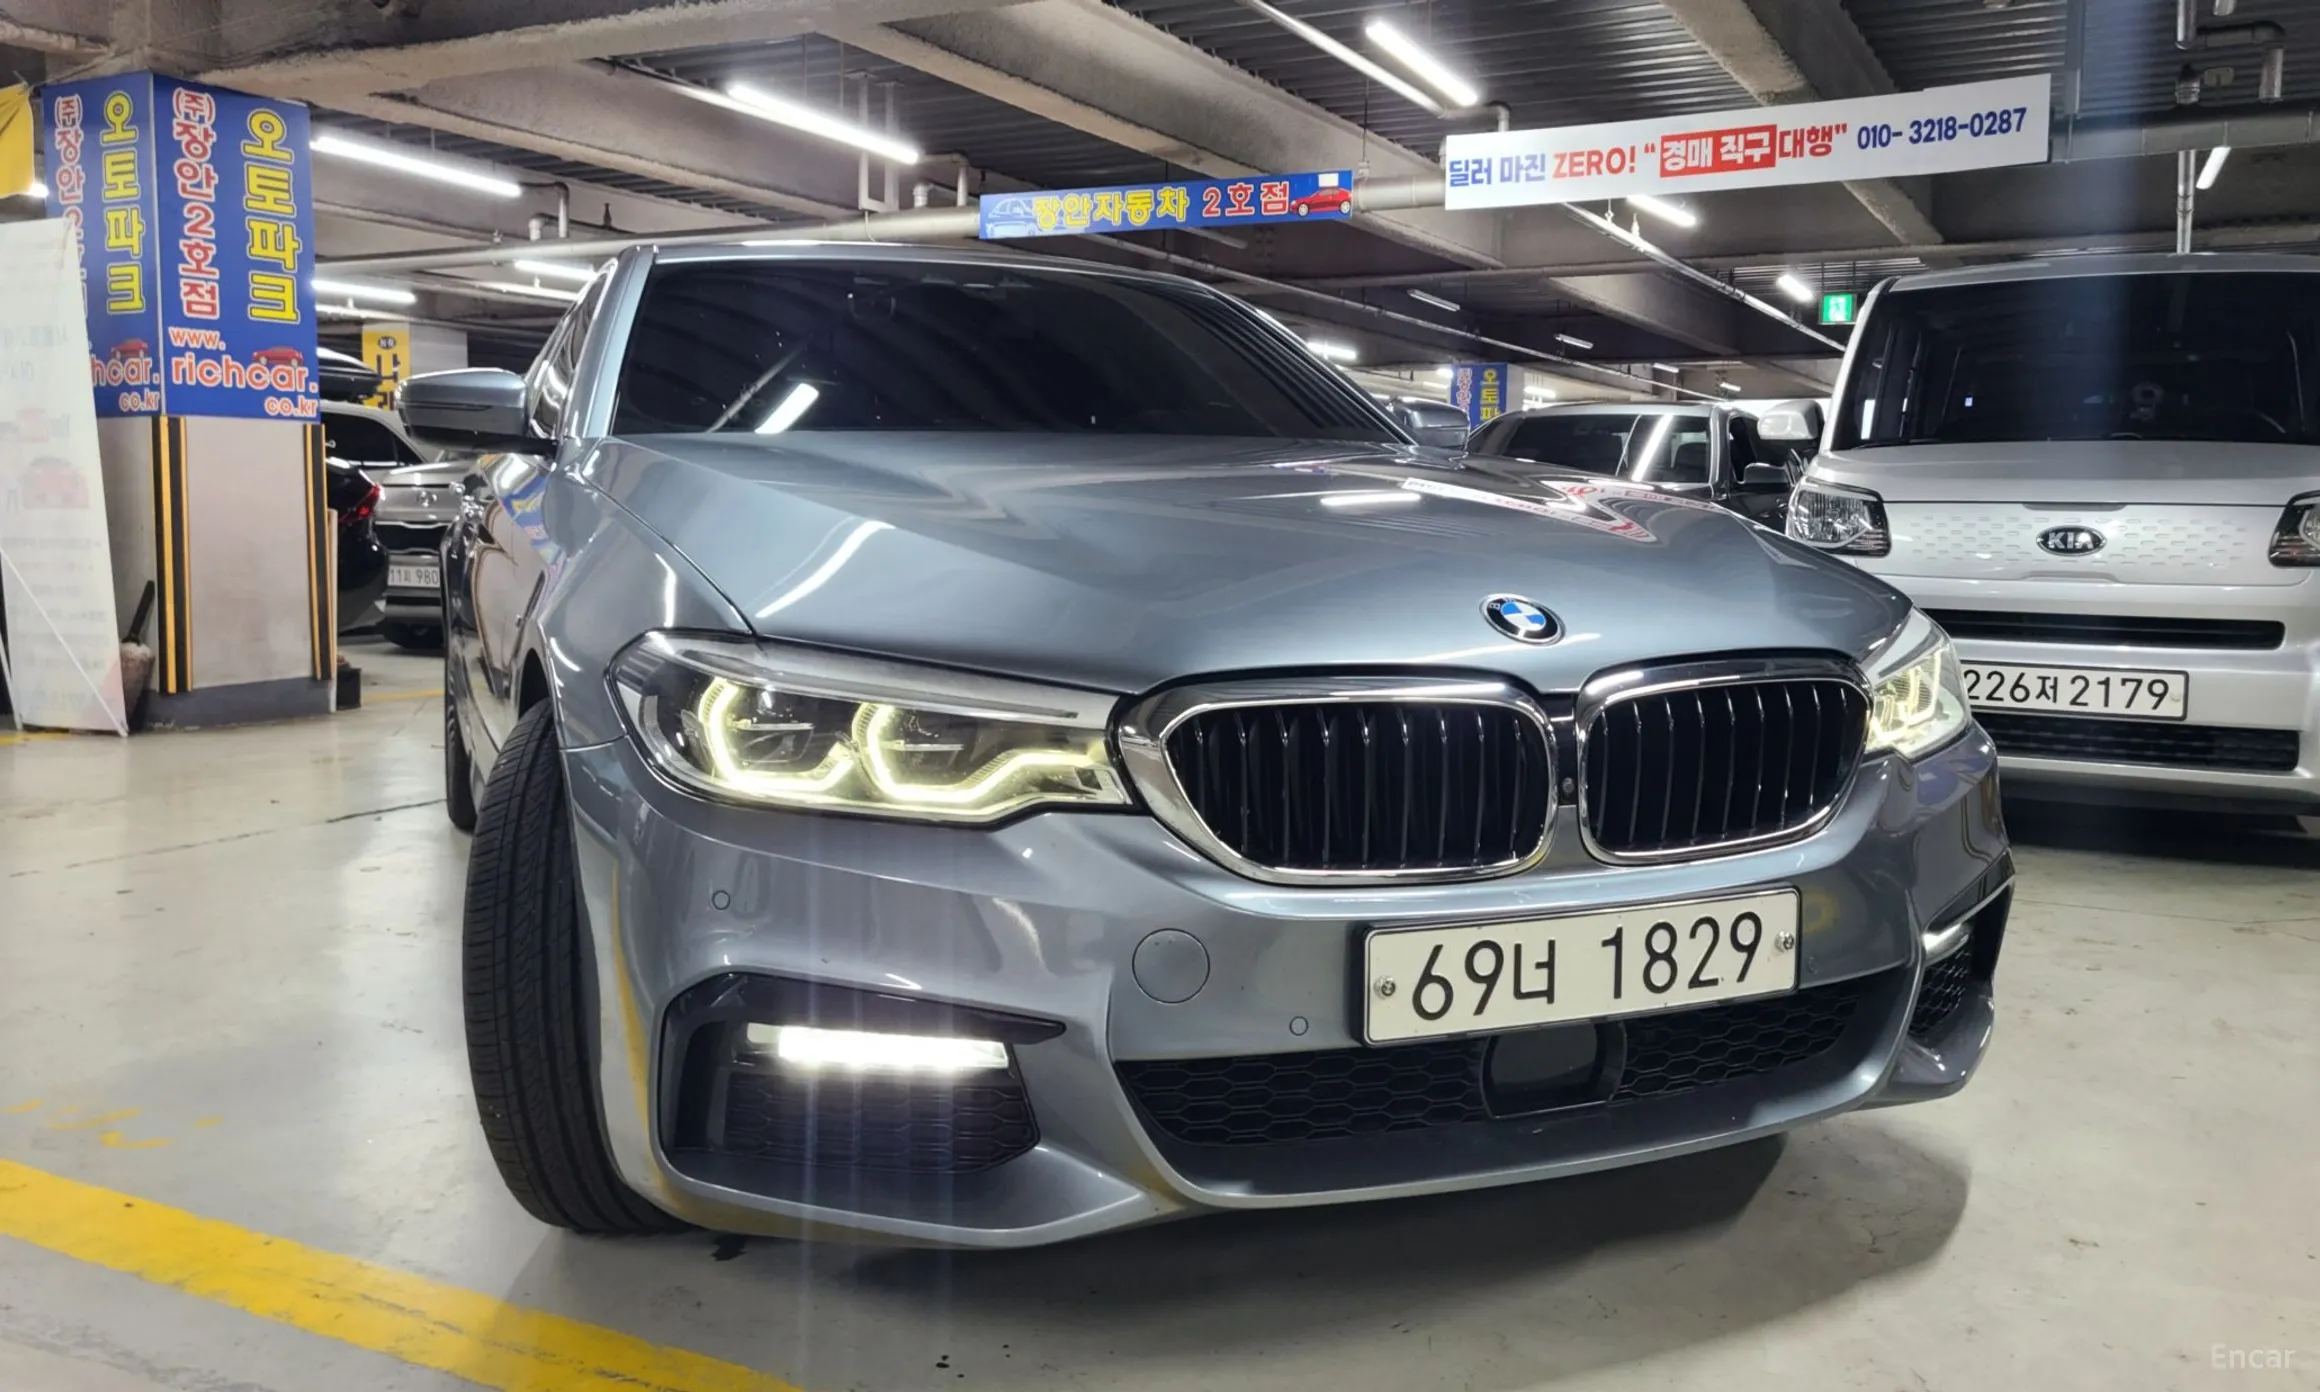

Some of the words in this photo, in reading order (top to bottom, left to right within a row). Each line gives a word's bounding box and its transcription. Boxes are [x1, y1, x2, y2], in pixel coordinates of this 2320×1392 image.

[1450, 158, 1493, 187] 딜러
[1500, 153, 1546, 183] 마진
[1552, 145, 1636, 178] ZERO!
[1719, 130, 1773, 166] 직구
[101, 90, 146, 314] 오토파크
[241, 108, 301, 324] 오토파크
[1032, 187, 1189, 231] 장안자동차
[1202, 181, 1290, 218] 2호점
[168, 326, 226, 350] www.
[90, 354, 160, 387] hcar.
[171, 352, 319, 393] richcar.
[119, 388, 160, 412] co.kr
[264, 395, 319, 417] co.kr
[1480, 368, 1500, 421] 오토파
[2047, 531, 2096, 551] KIA
[416, 569, 440, 585] 980
[1963, 669, 2059, 704] 226저
[2069, 674, 2170, 710] 2179
[1411, 938, 1556, 1021] 69너
[1601, 910, 1763, 1000] 1829
